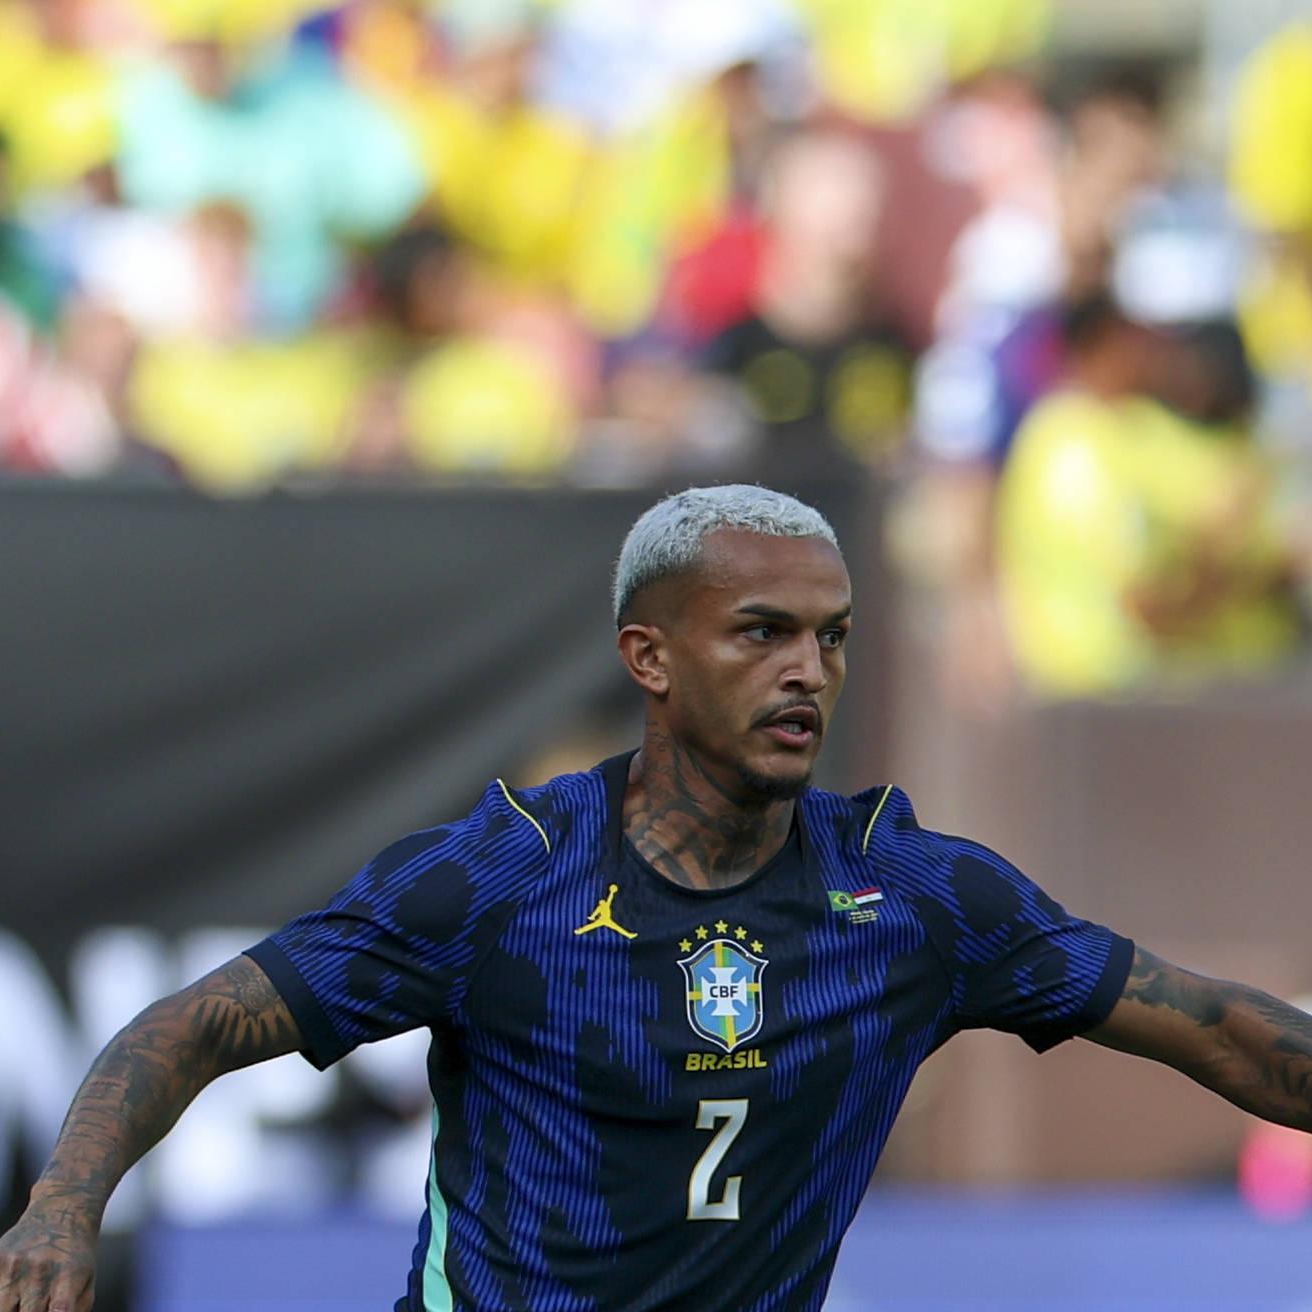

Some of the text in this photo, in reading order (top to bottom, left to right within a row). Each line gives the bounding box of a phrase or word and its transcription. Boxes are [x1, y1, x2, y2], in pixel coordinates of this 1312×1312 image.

[710, 985, 738, 998] CBF
[686, 1050, 767, 1071] BRASIL
[686, 1098, 749, 1221] 2
